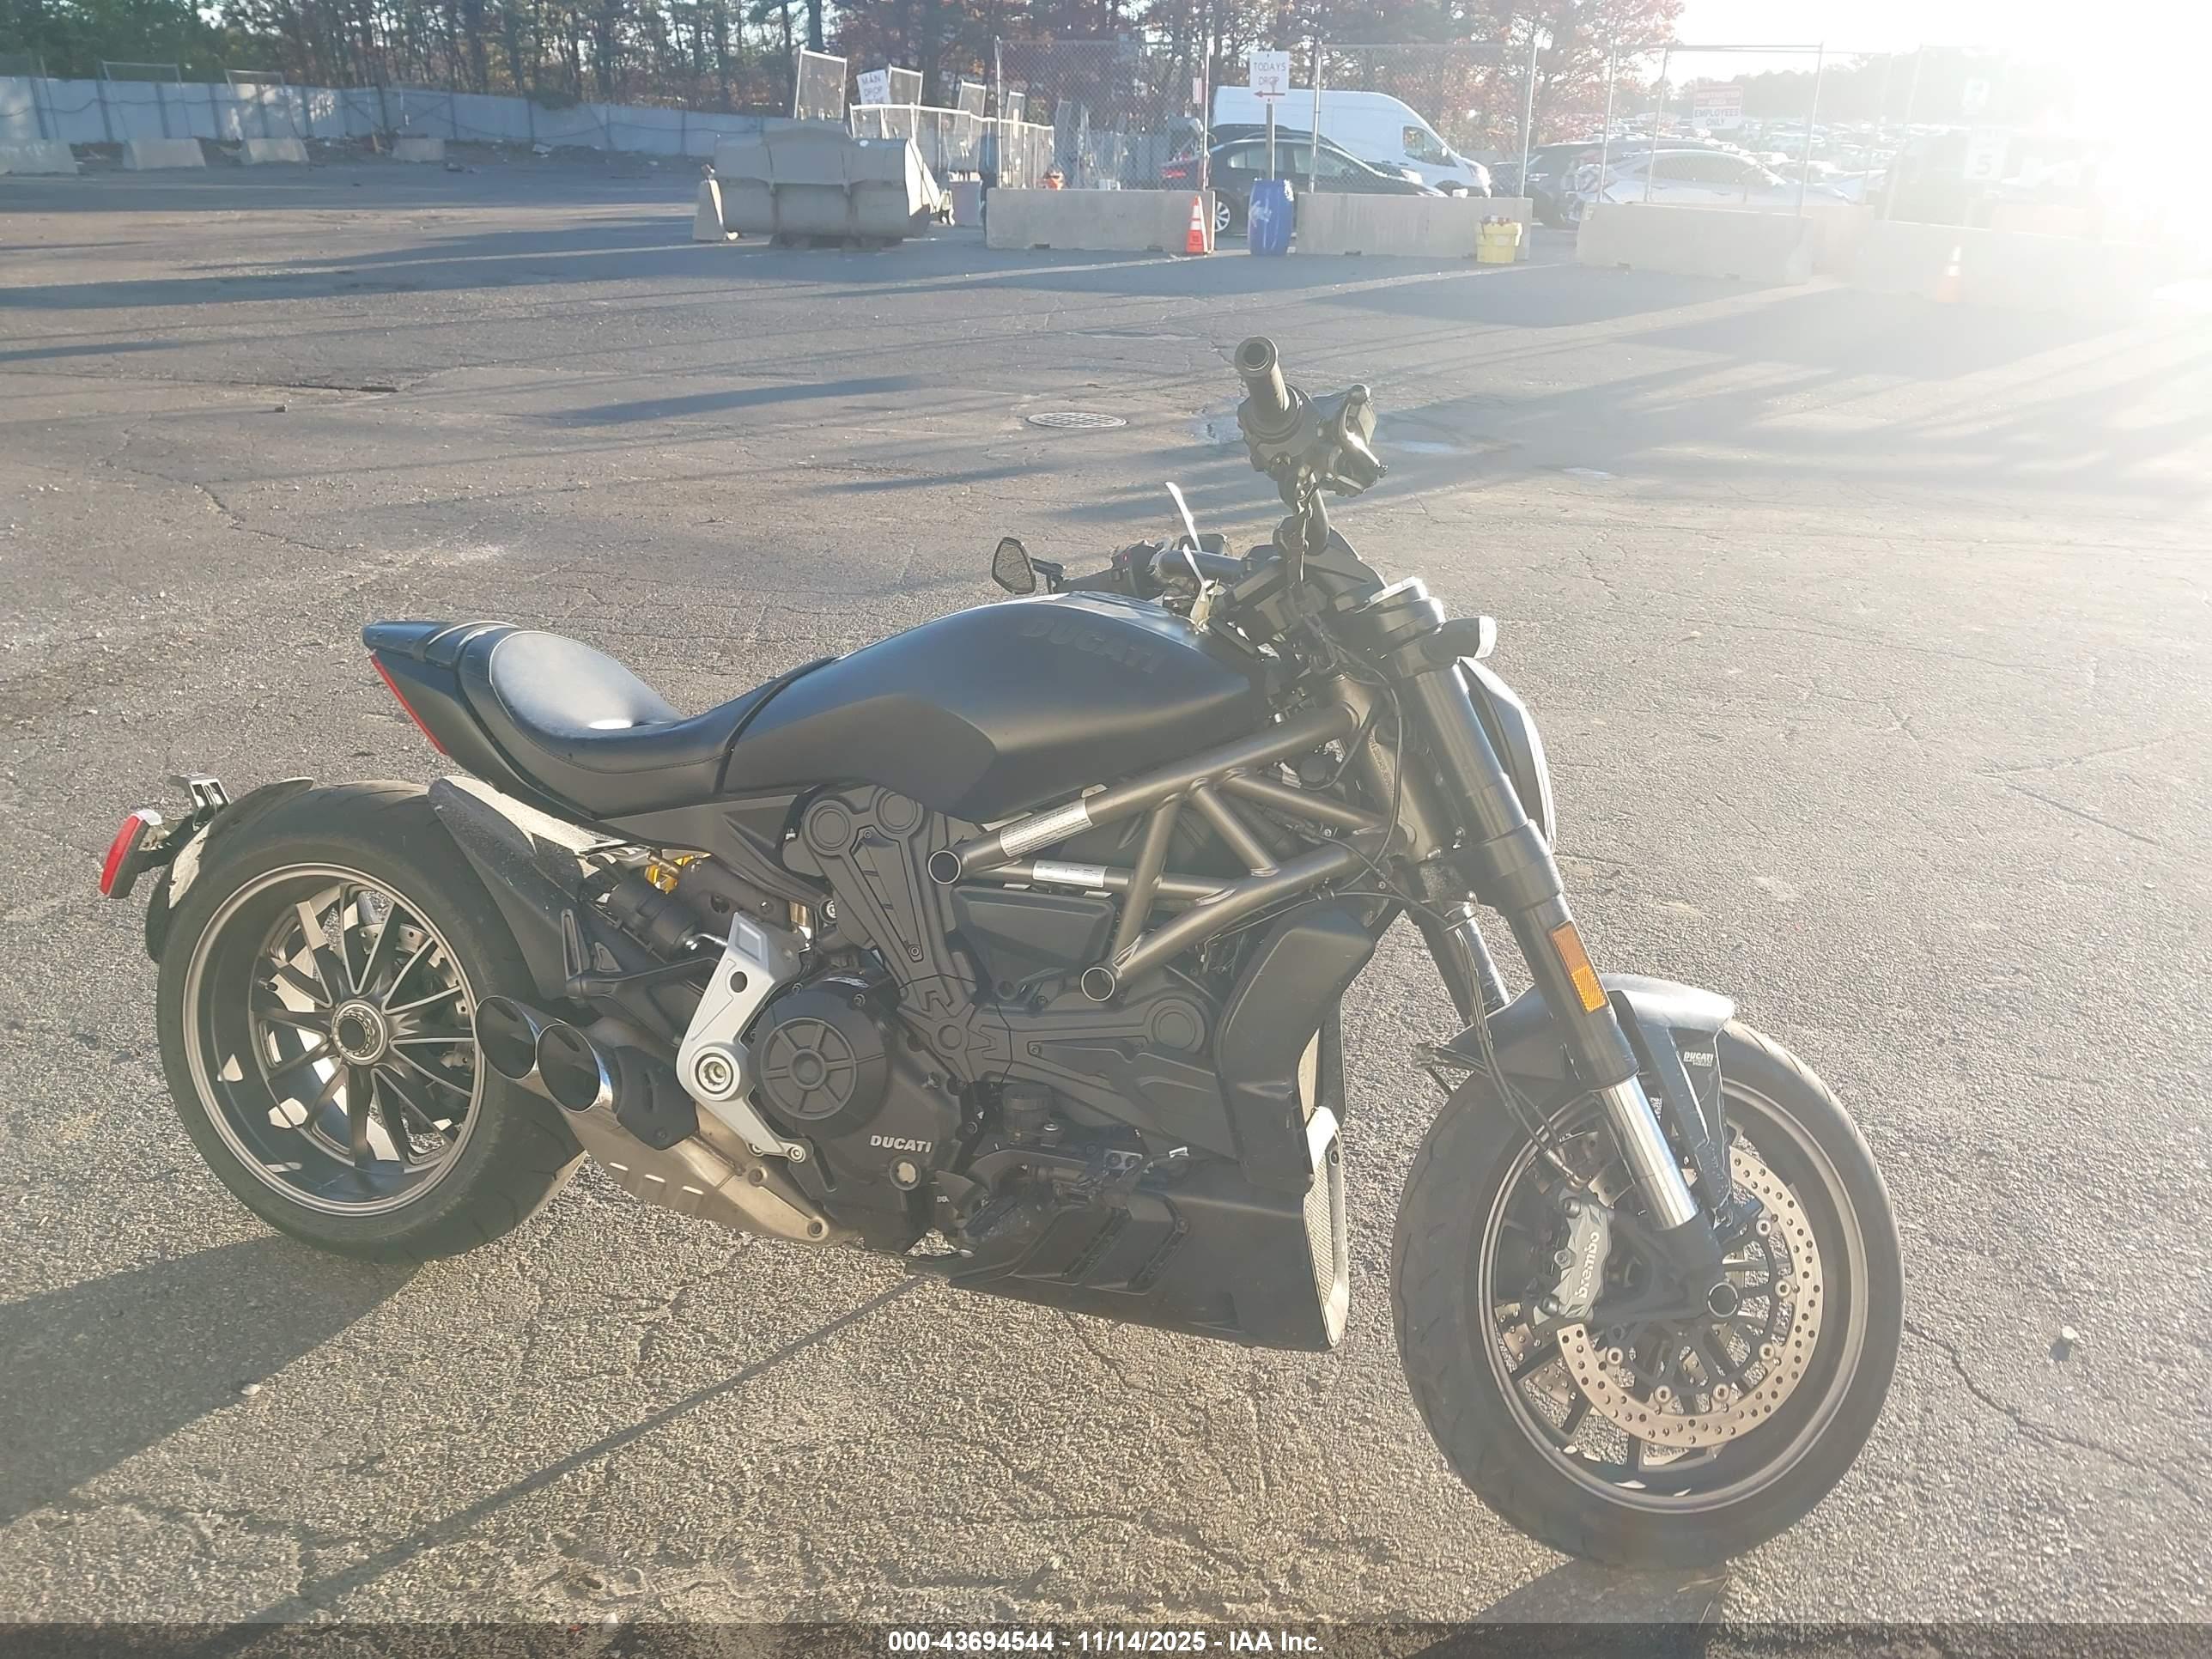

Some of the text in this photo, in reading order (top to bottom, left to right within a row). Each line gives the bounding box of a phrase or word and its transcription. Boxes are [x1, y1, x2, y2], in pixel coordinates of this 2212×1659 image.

[1254, 62, 1285, 71] TODAYS
[1694, 109, 1739, 118] EMPLOYEES
[1705, 118, 1725, 126] ONLY
[1020, 617, 1162, 674] DUCATI
[1684, 1052, 1714, 1060] DUCATI
[870, 1135, 932, 1152] DUCATI
[1575, 1231, 1600, 1299] brembo
